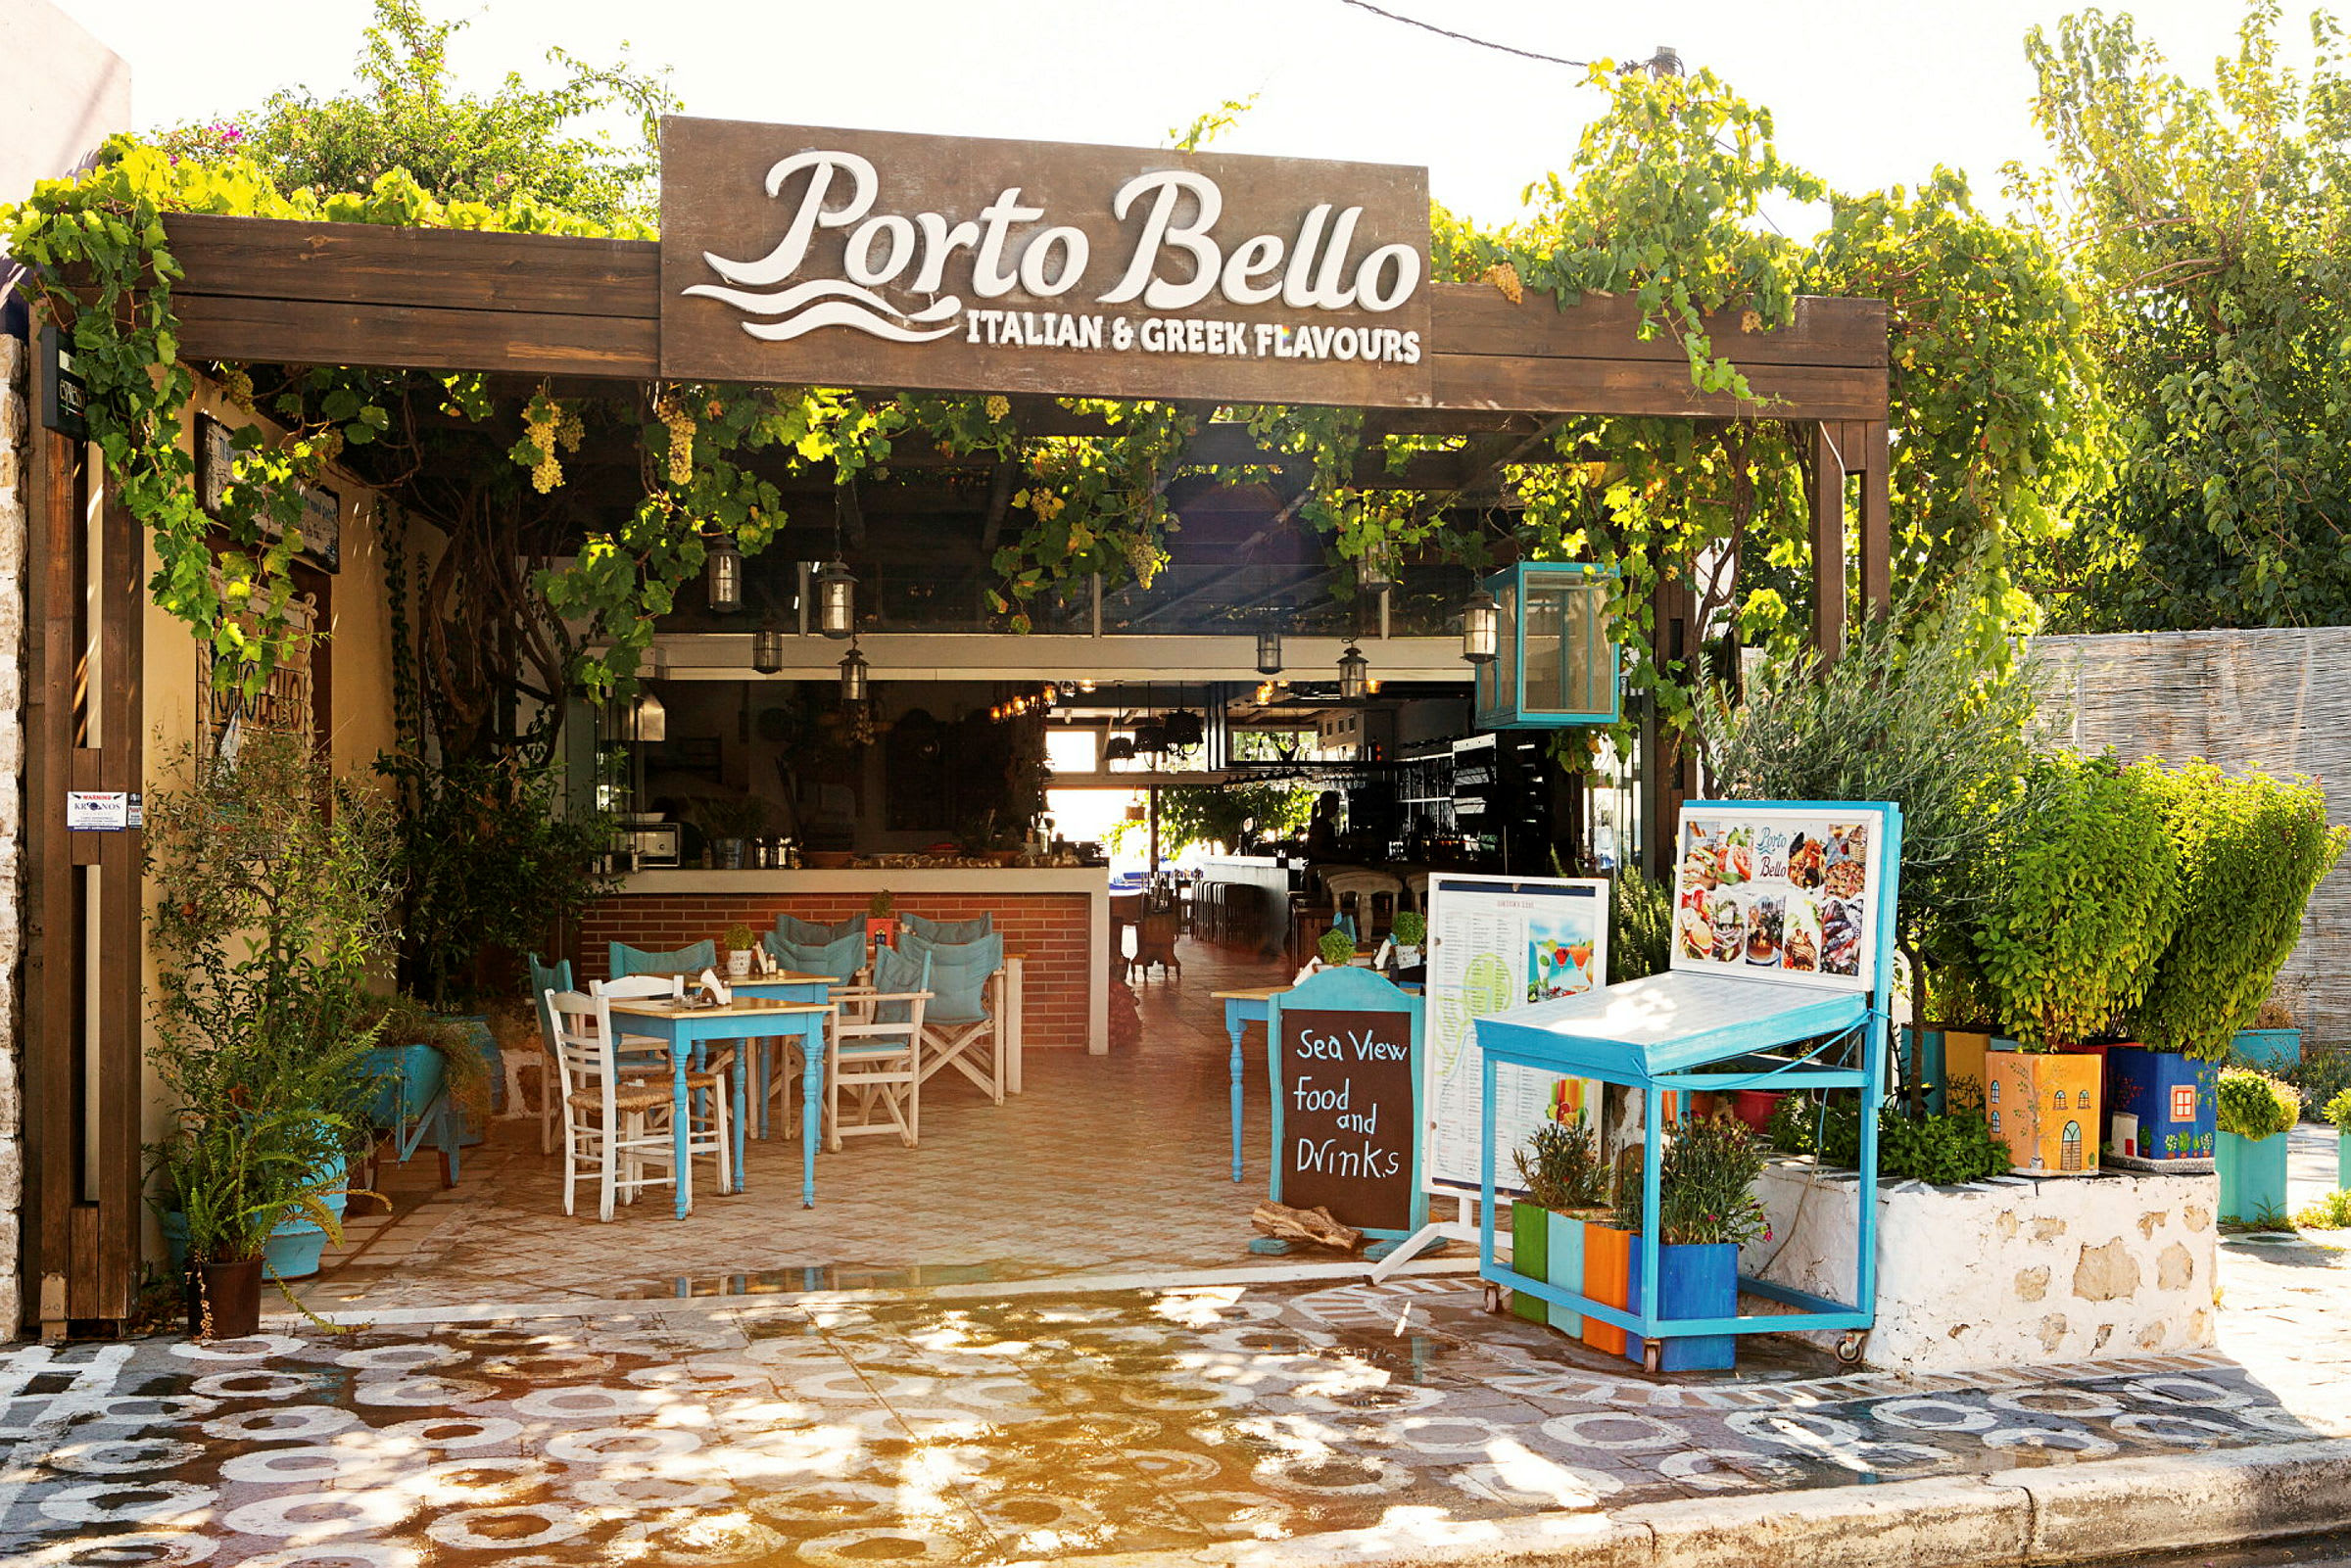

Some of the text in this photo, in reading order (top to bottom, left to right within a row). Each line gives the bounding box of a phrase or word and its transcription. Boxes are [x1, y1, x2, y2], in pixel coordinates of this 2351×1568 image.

[702, 150, 1421, 312] Porto Bello
[966, 309, 1422, 365] ITALIAN & GREEK FLAVOURS
[1757, 826, 1788, 848] Porto
[1760, 855, 1787, 878] Bello
[1296, 1029, 1409, 1061] Sea View
[1293, 1075, 1351, 1111] Food
[1336, 1103, 1377, 1135] and
